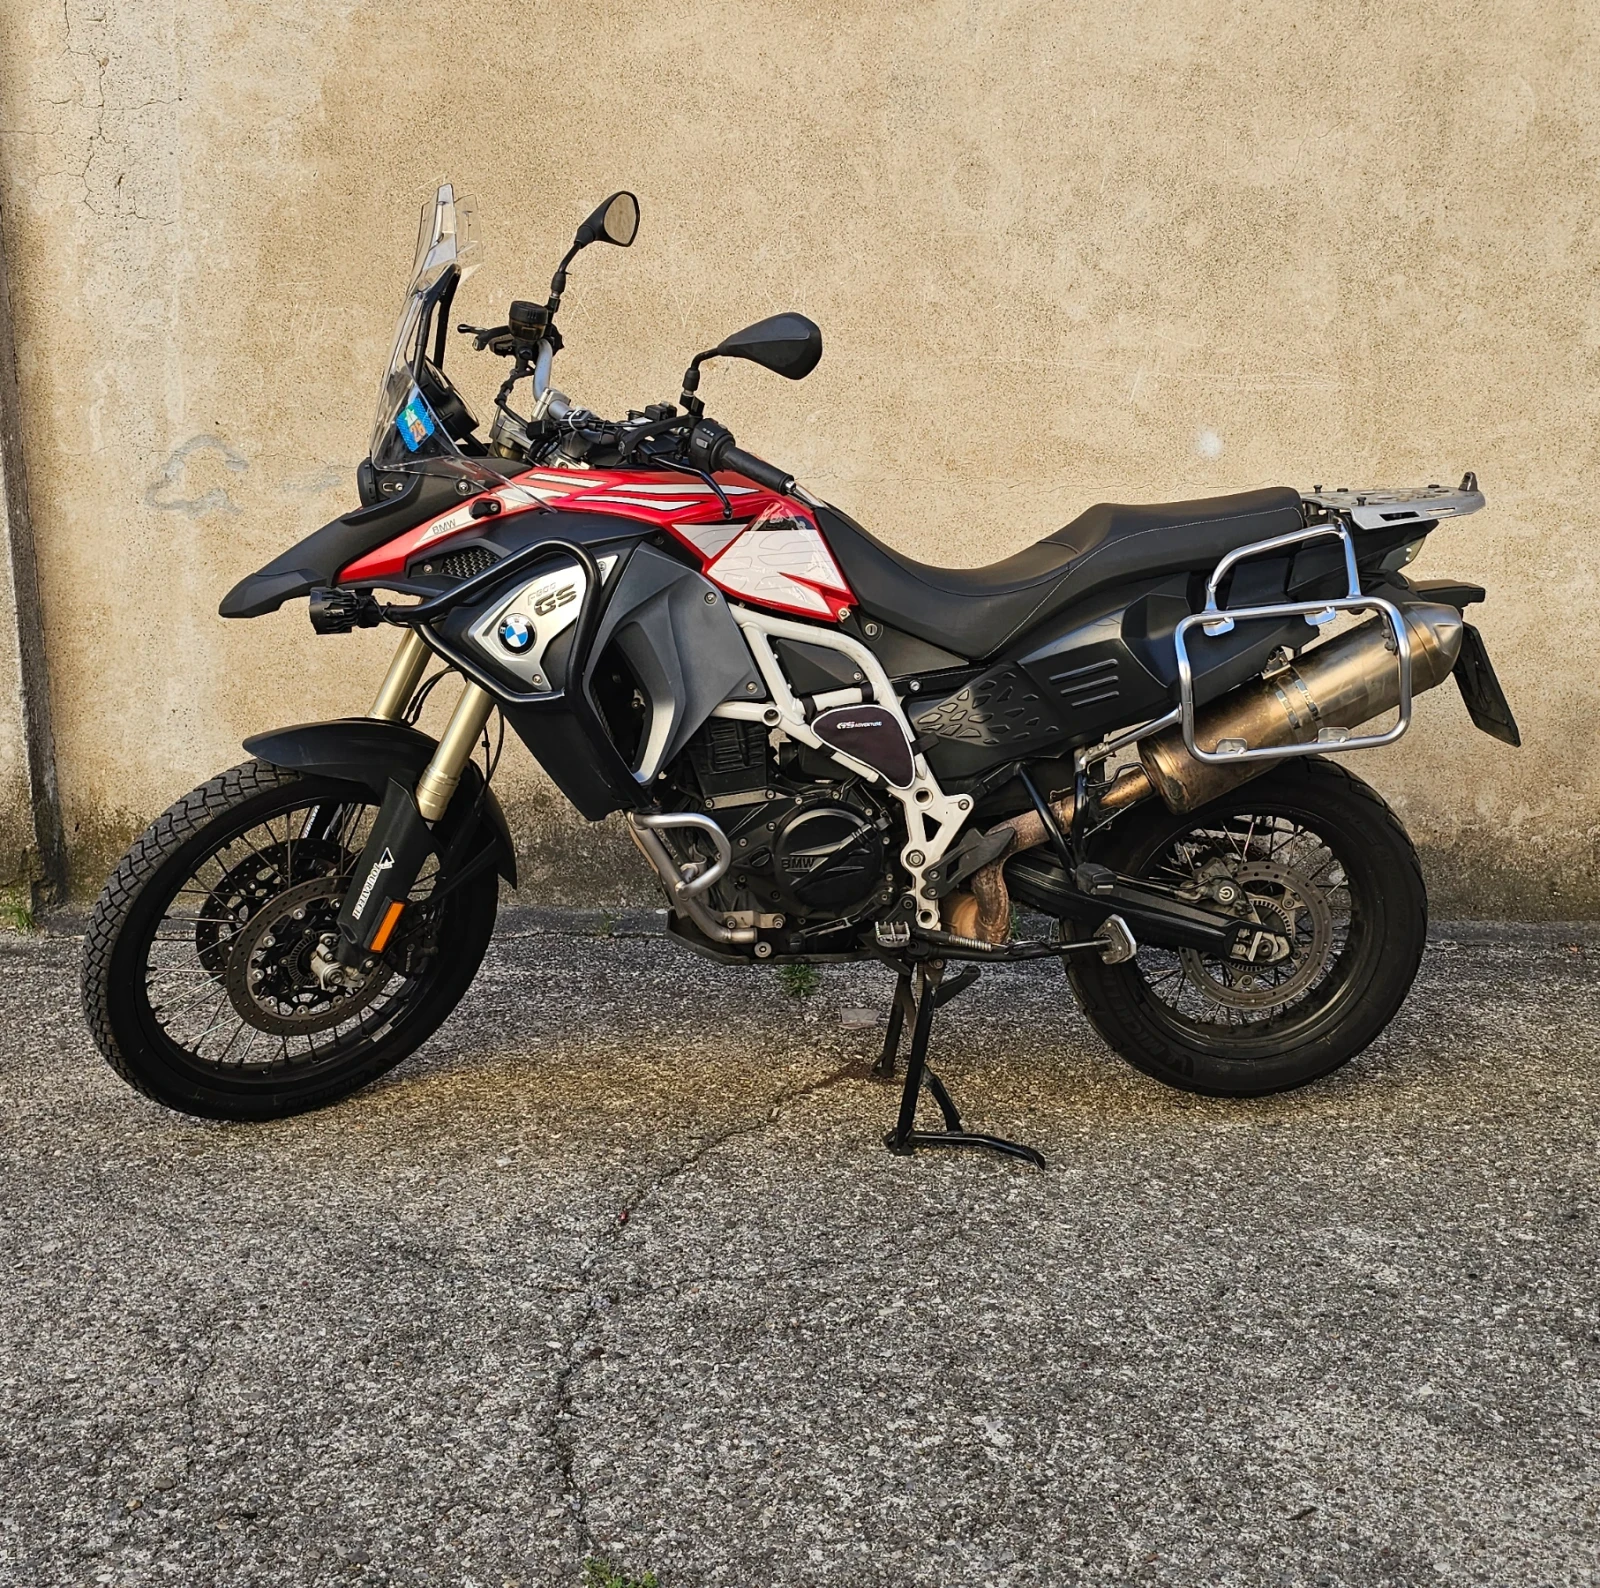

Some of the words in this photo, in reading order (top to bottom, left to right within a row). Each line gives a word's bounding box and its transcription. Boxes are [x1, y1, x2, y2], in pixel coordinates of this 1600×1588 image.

[432, 518, 456, 535] BMW
[534, 582, 577, 617] GS
[836, 721, 855, 730] GS
[780, 856, 815, 869] BMW
[351, 862, 382, 920] TOURATECH
